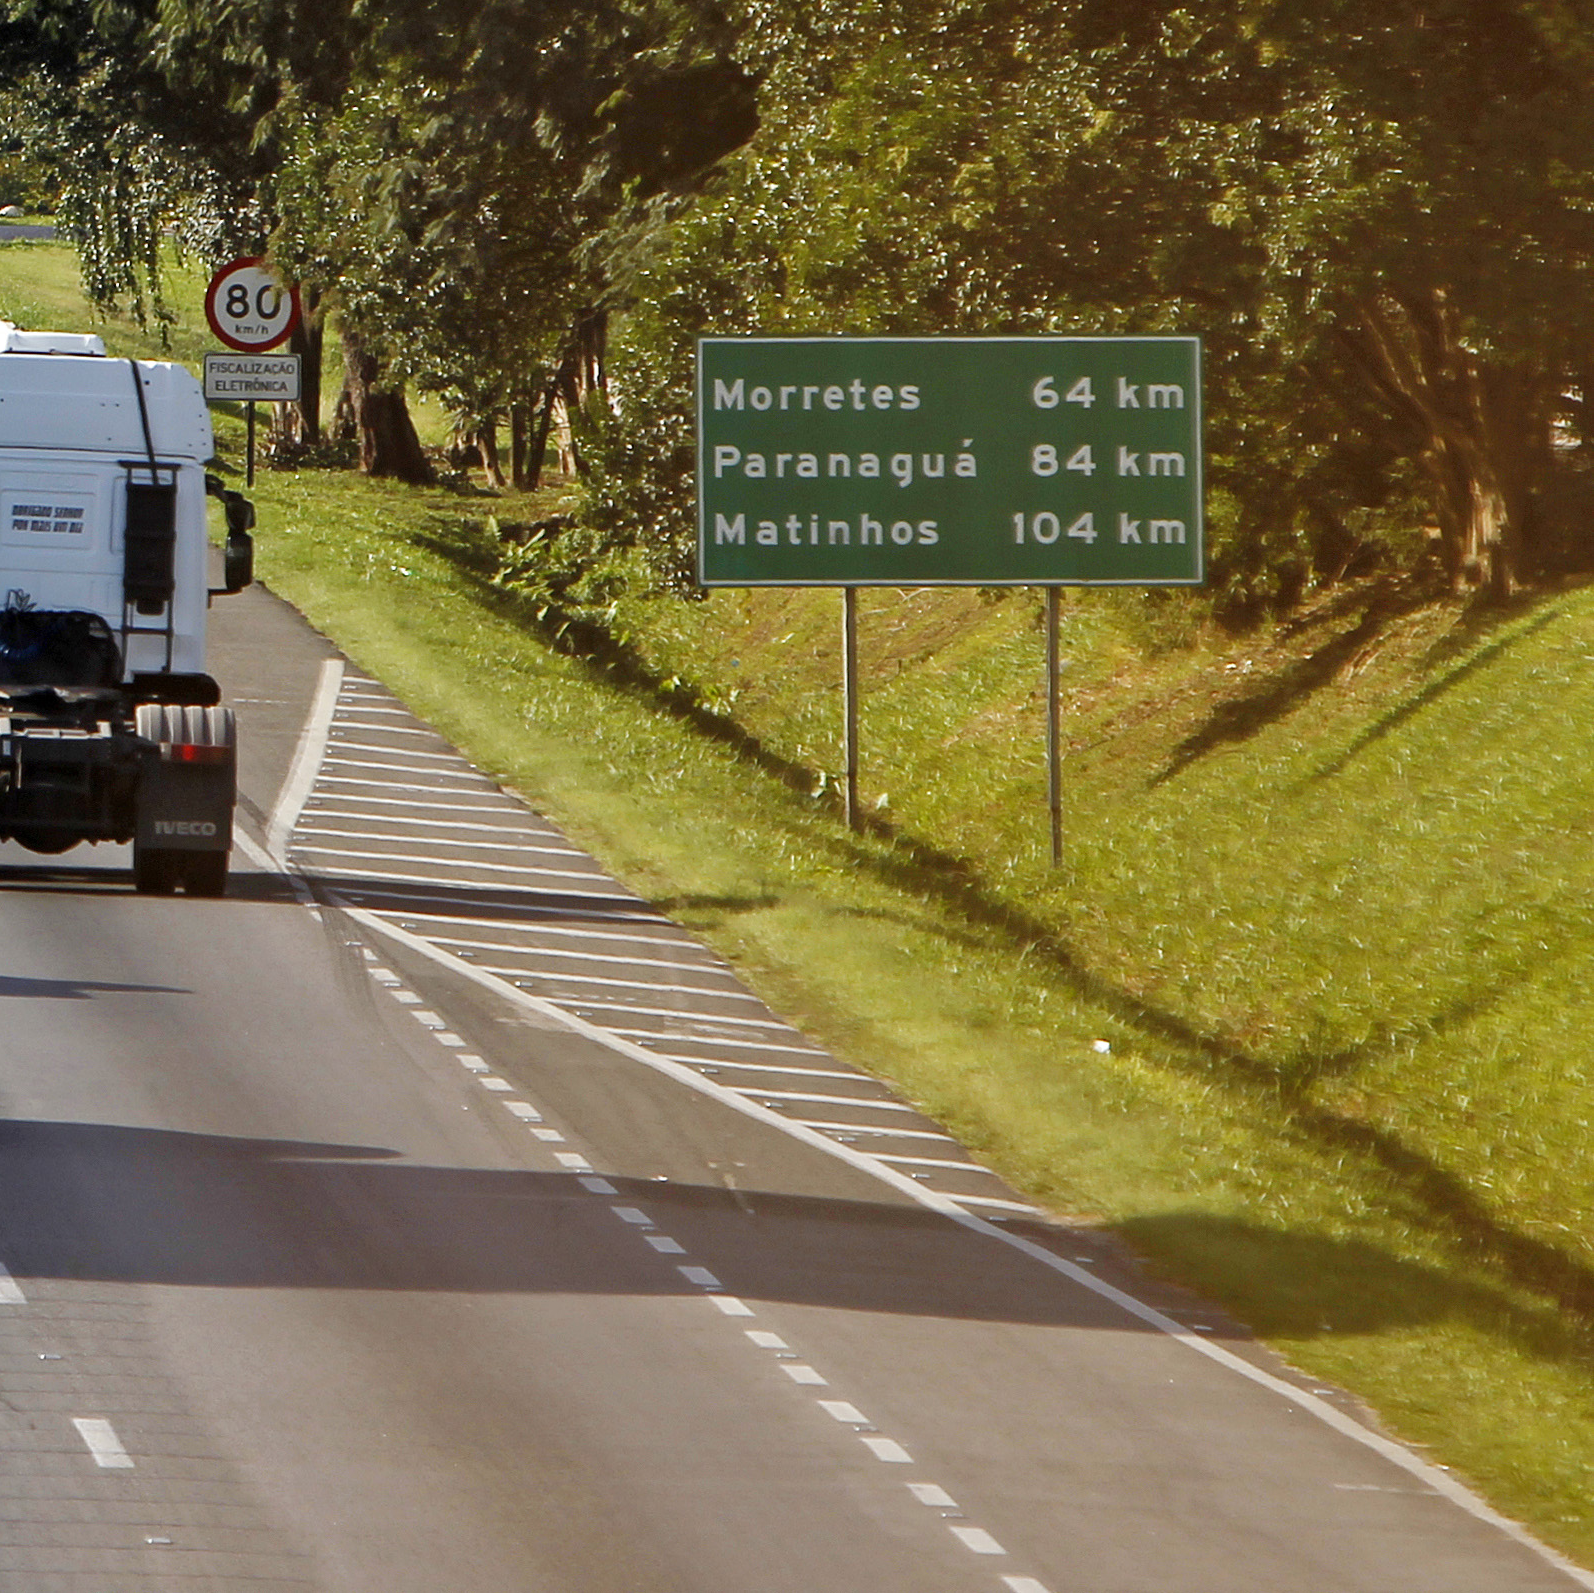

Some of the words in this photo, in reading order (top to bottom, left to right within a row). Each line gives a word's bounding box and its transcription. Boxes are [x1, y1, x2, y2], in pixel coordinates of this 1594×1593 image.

[225, 284, 282, 320] 80
[235, 324, 269, 335] km/h
[209, 361, 295, 376] FISCALIZAÇÃO
[215, 377, 288, 392] ELETRÔNICA
[713, 377, 921, 411] Morretes
[1032, 376, 1096, 409] 64
[1118, 376, 1185, 409] km
[714, 438, 978, 488] Paranaguá
[1030, 443, 1097, 478] 84
[1118, 443, 1186, 478] km
[714, 512, 940, 546] Matinhos
[1012, 511, 1098, 545] 104
[1119, 511, 1187, 545] km
[154, 820, 217, 836] IVECO
